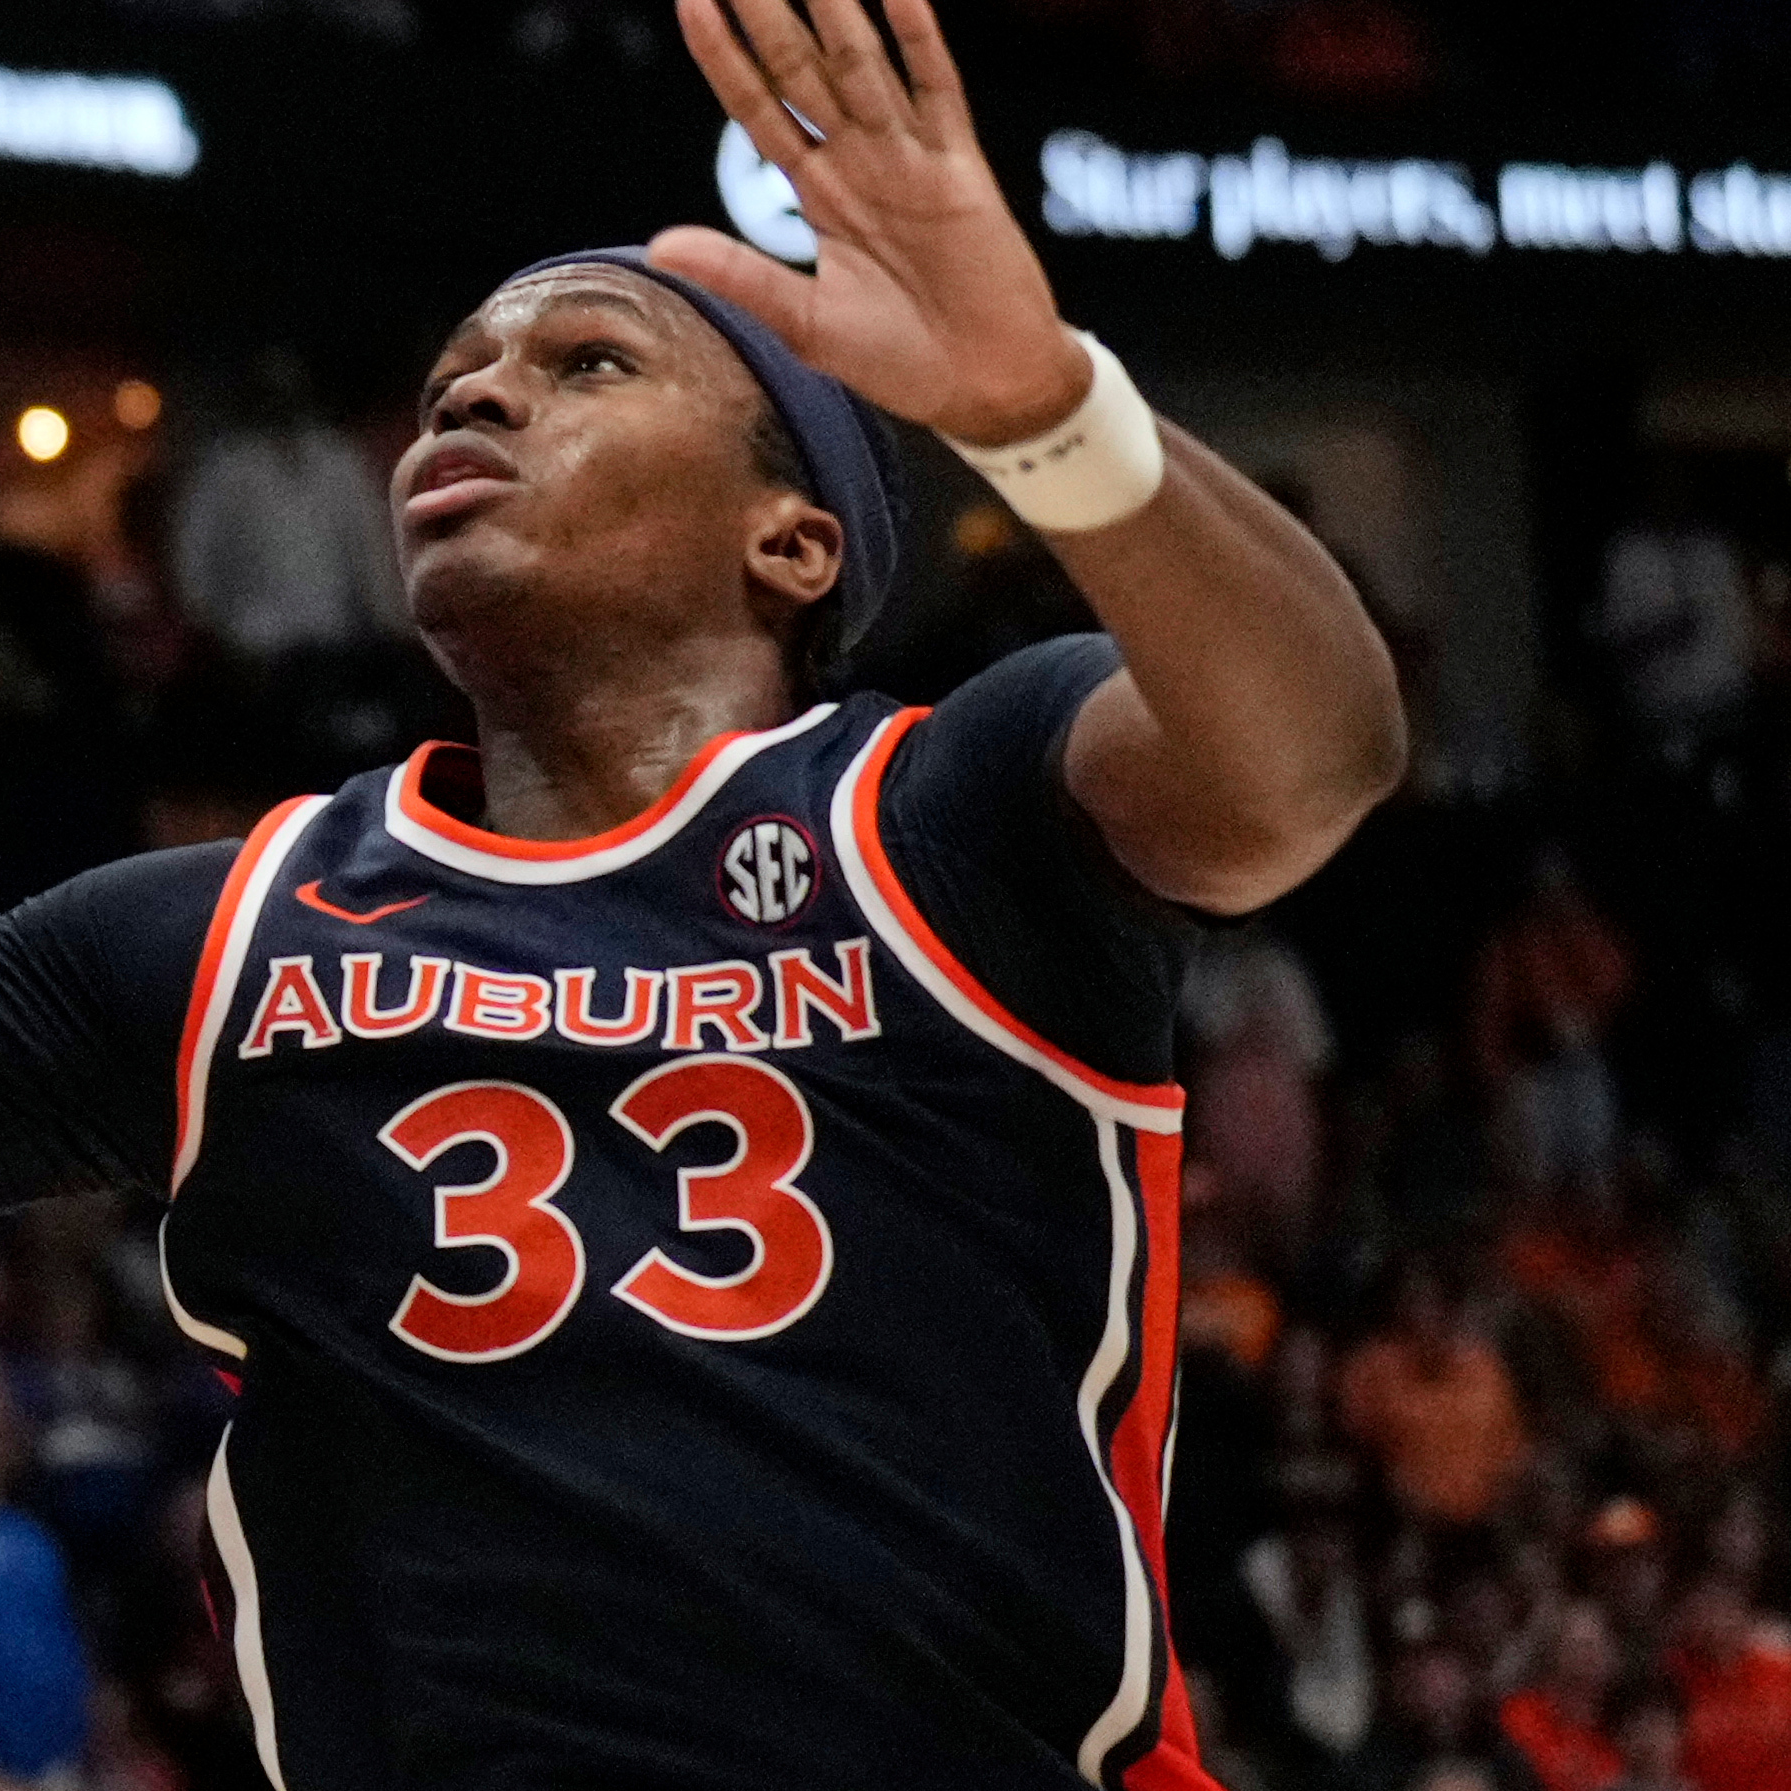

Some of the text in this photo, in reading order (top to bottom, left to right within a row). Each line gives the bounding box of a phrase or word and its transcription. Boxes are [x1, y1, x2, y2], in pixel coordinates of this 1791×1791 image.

[1040, 130, 1205, 236] Star
[723, 820, 813, 924] SEC
[238, 935, 881, 1058] AUBURN
[379, 1051, 835, 1365] 33
